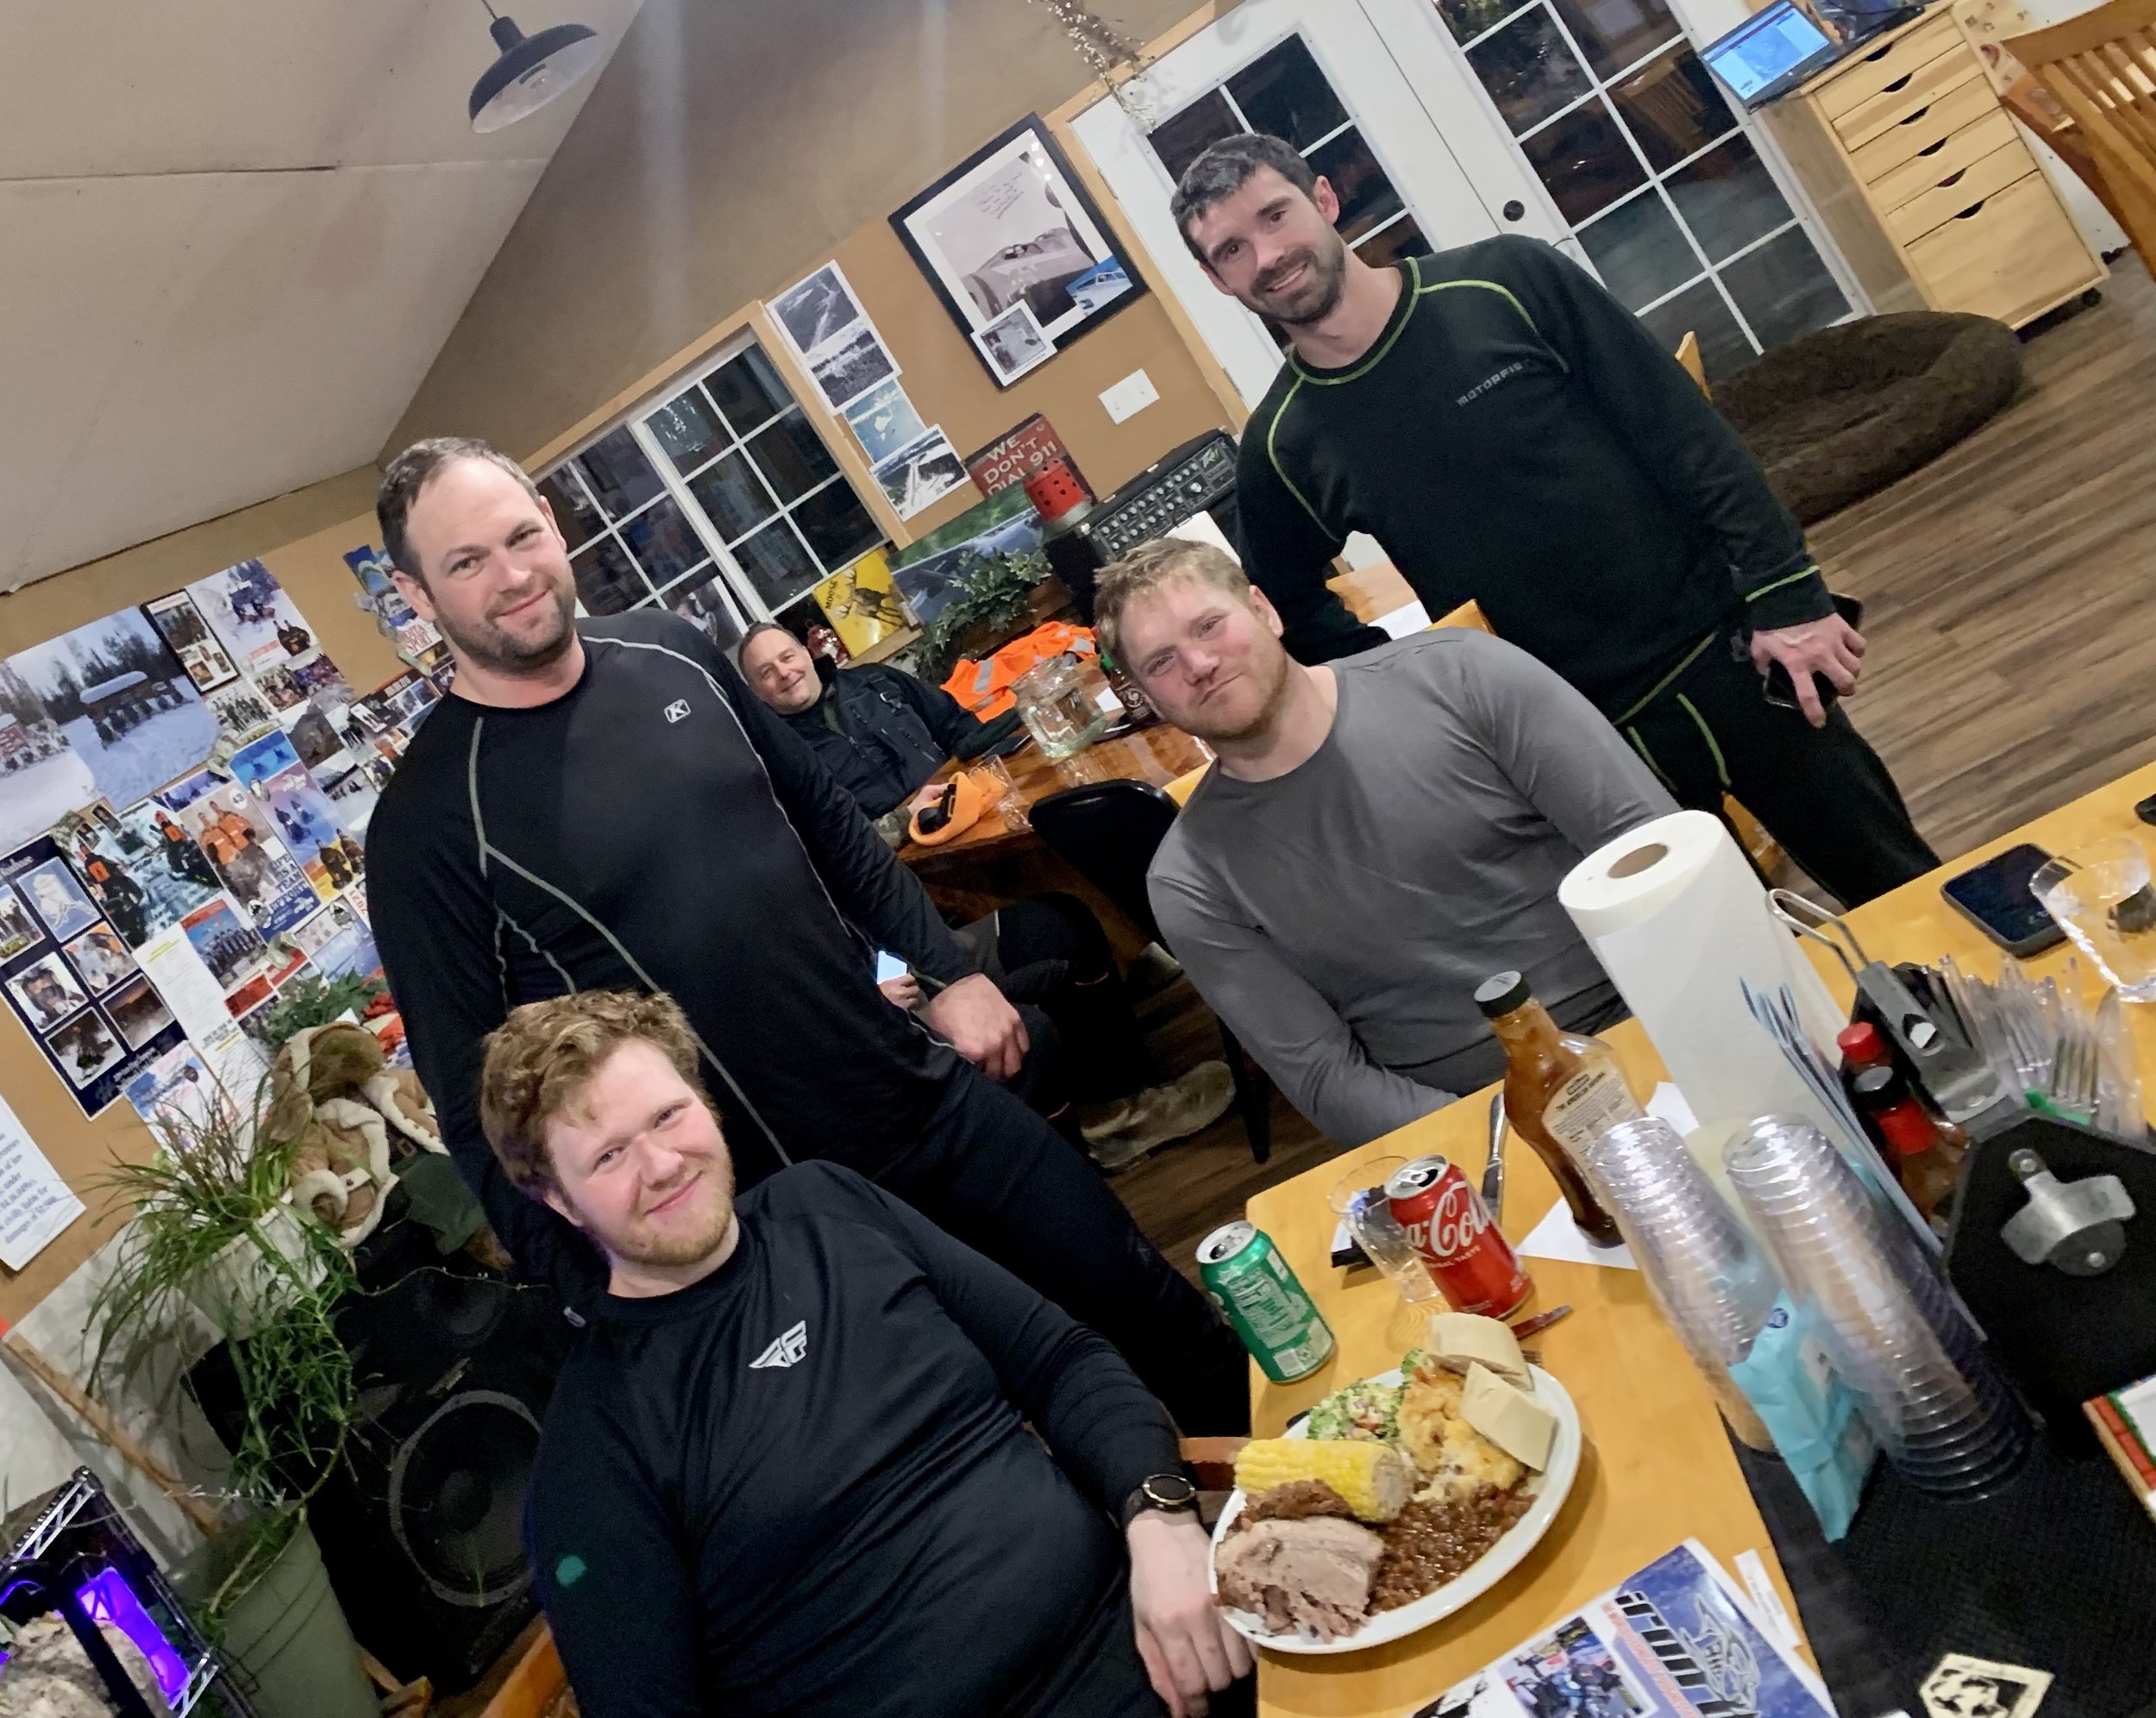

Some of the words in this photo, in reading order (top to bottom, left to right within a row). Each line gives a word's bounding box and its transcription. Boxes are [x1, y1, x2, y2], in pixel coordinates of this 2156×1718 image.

[1456, 360, 1528, 407] MOTORFIS
[983, 437, 1037, 484] DON'T
[987, 435, 1020, 461] WE
[987, 467, 1026, 496] DIAL
[1030, 441, 1057, 467] 911
[825, 580, 838, 610] MOOSE
[274, 870, 304, 893] TEAM
